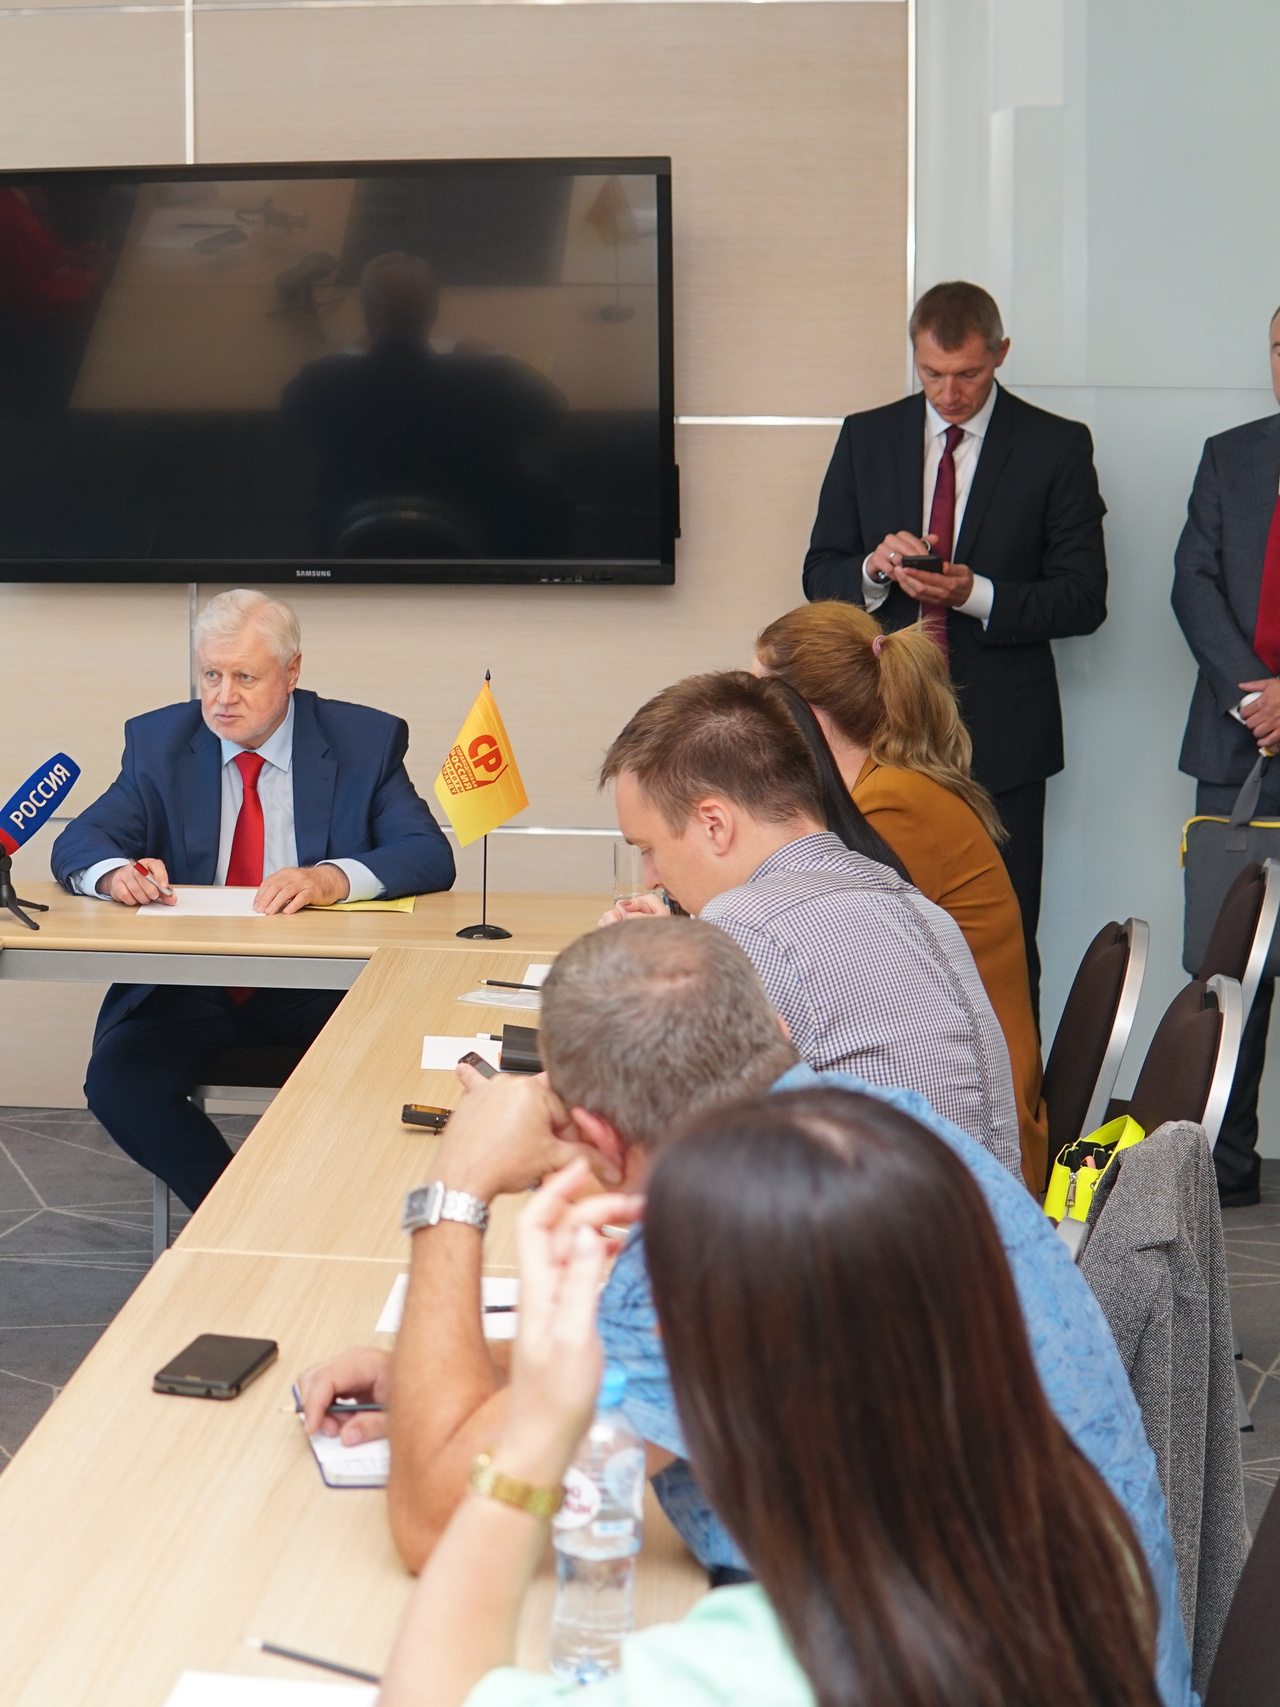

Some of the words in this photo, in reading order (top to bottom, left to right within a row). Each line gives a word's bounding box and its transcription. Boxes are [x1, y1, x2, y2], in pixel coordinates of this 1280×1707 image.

[295, 569, 332, 577] SAMSUNG
[450, 749, 473, 791] РОССИЯ
[468, 734, 503, 773] СР
[445, 759, 464, 793] ТРИОТЫ
[9, 763, 71, 830] РОССИЯ
